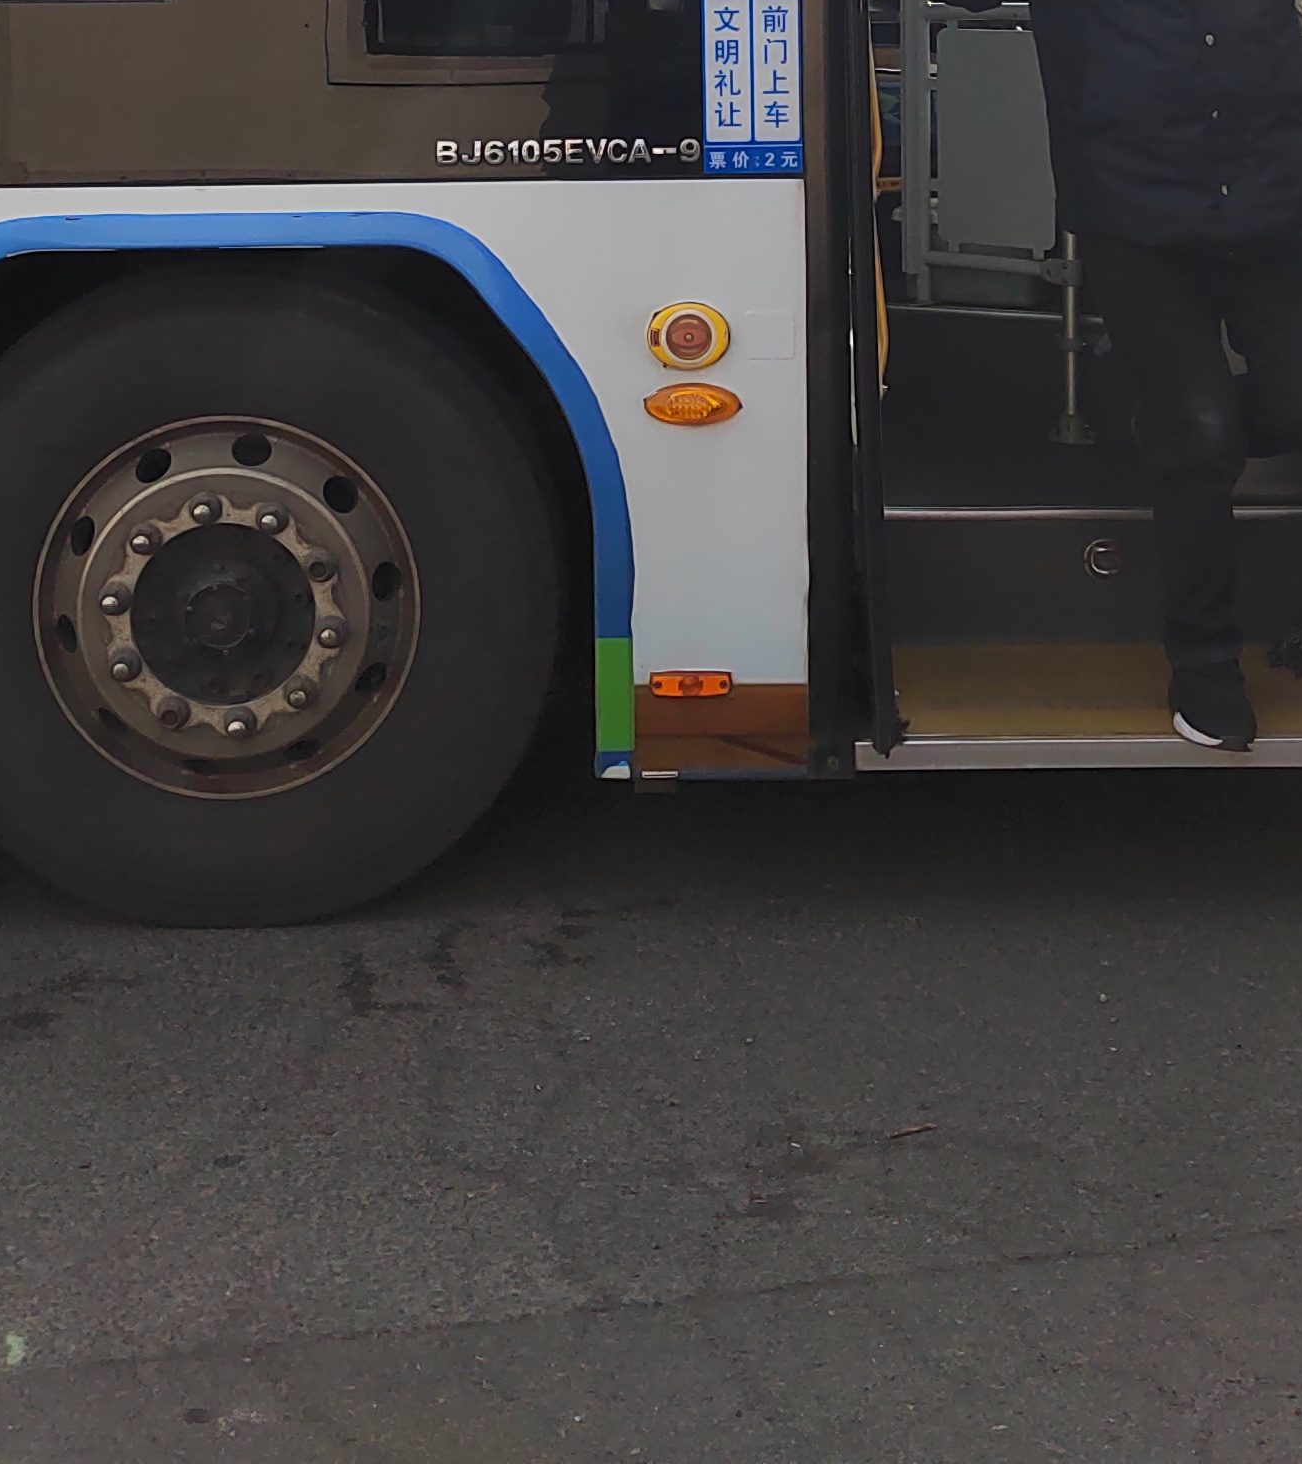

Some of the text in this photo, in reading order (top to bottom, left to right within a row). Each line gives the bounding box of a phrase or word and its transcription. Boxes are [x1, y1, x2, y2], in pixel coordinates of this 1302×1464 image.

[713, 6, 742, 128] 文明礼让
[762, 5, 790, 129] 前门上车
[435, 138, 700, 165] BJ6105EVCA-9
